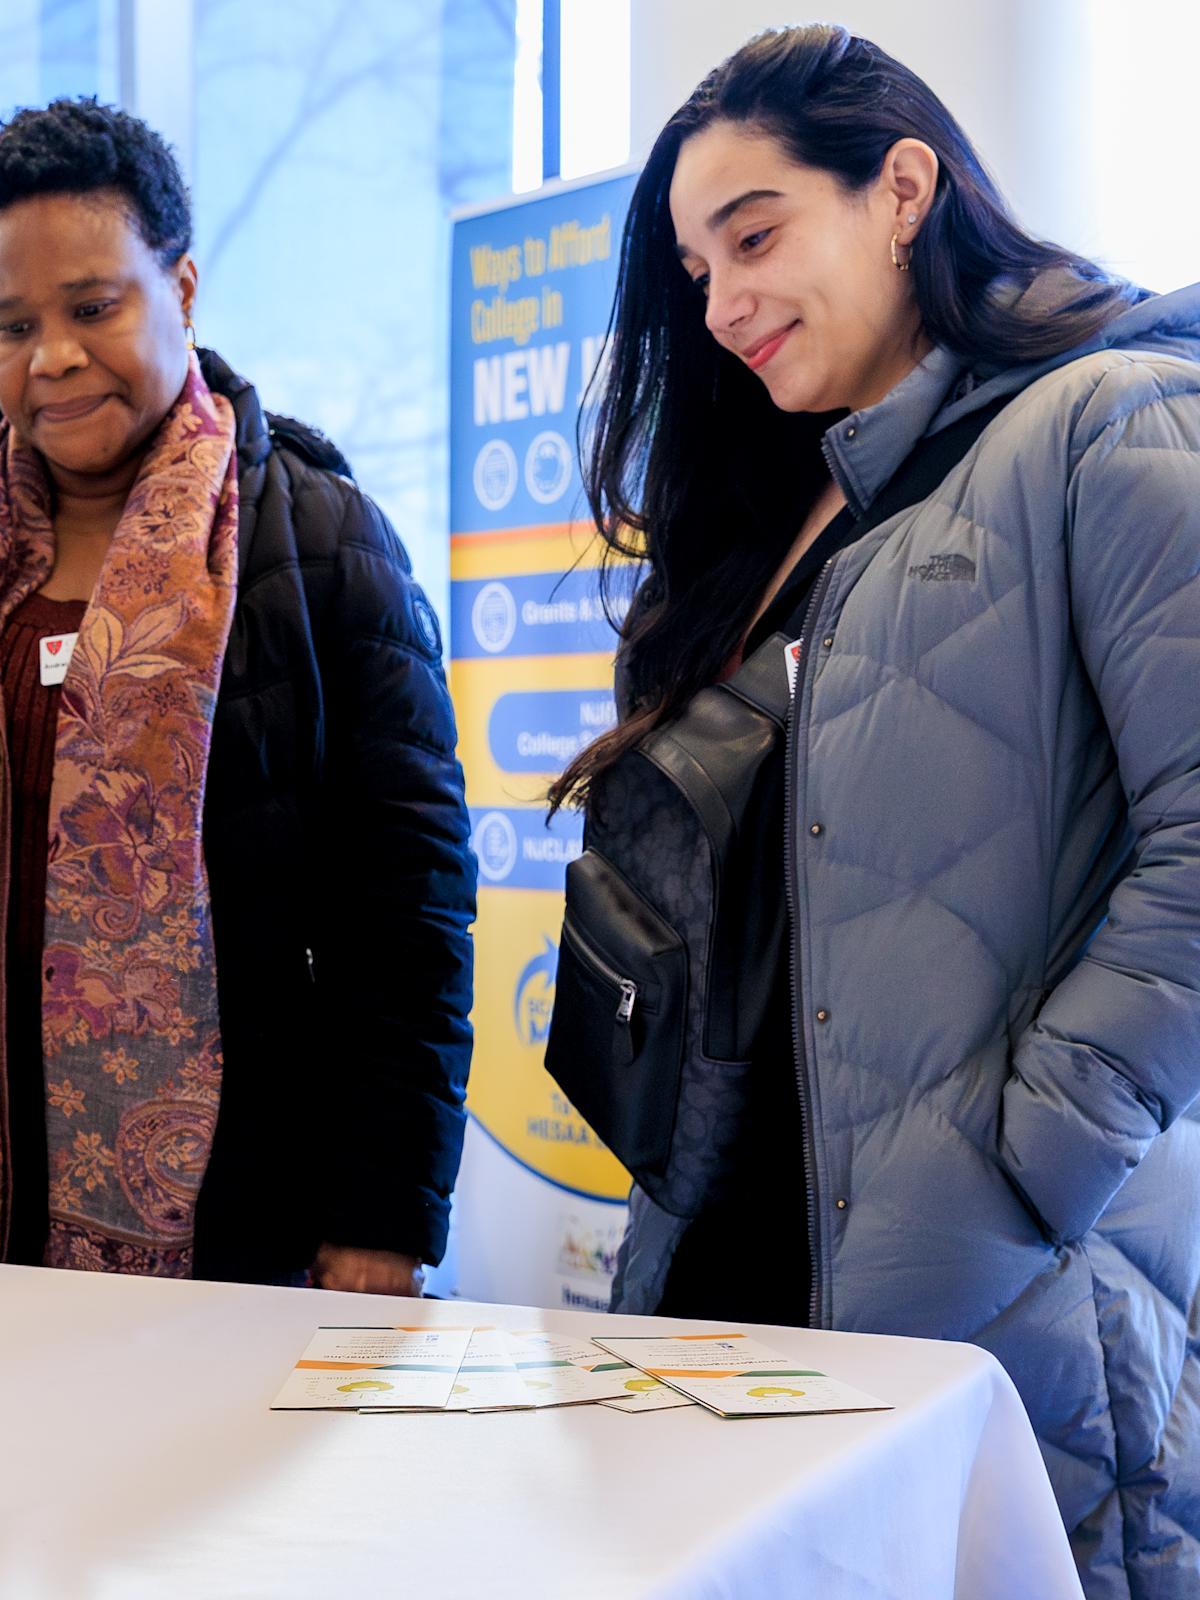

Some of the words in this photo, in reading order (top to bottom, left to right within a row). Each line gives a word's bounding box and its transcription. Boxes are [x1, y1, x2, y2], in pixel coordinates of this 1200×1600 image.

[470, 242, 521, 292] Ways
[524, 237, 545, 276] to
[549, 215, 611, 271] Afford
[471, 298, 538, 345] College
[542, 287, 563, 329] in
[473, 342, 570, 426] NEW
[521, 600, 576, 626] Grants
[516, 731, 577, 760] College
[527, 1117, 591, 1146] HESAA
